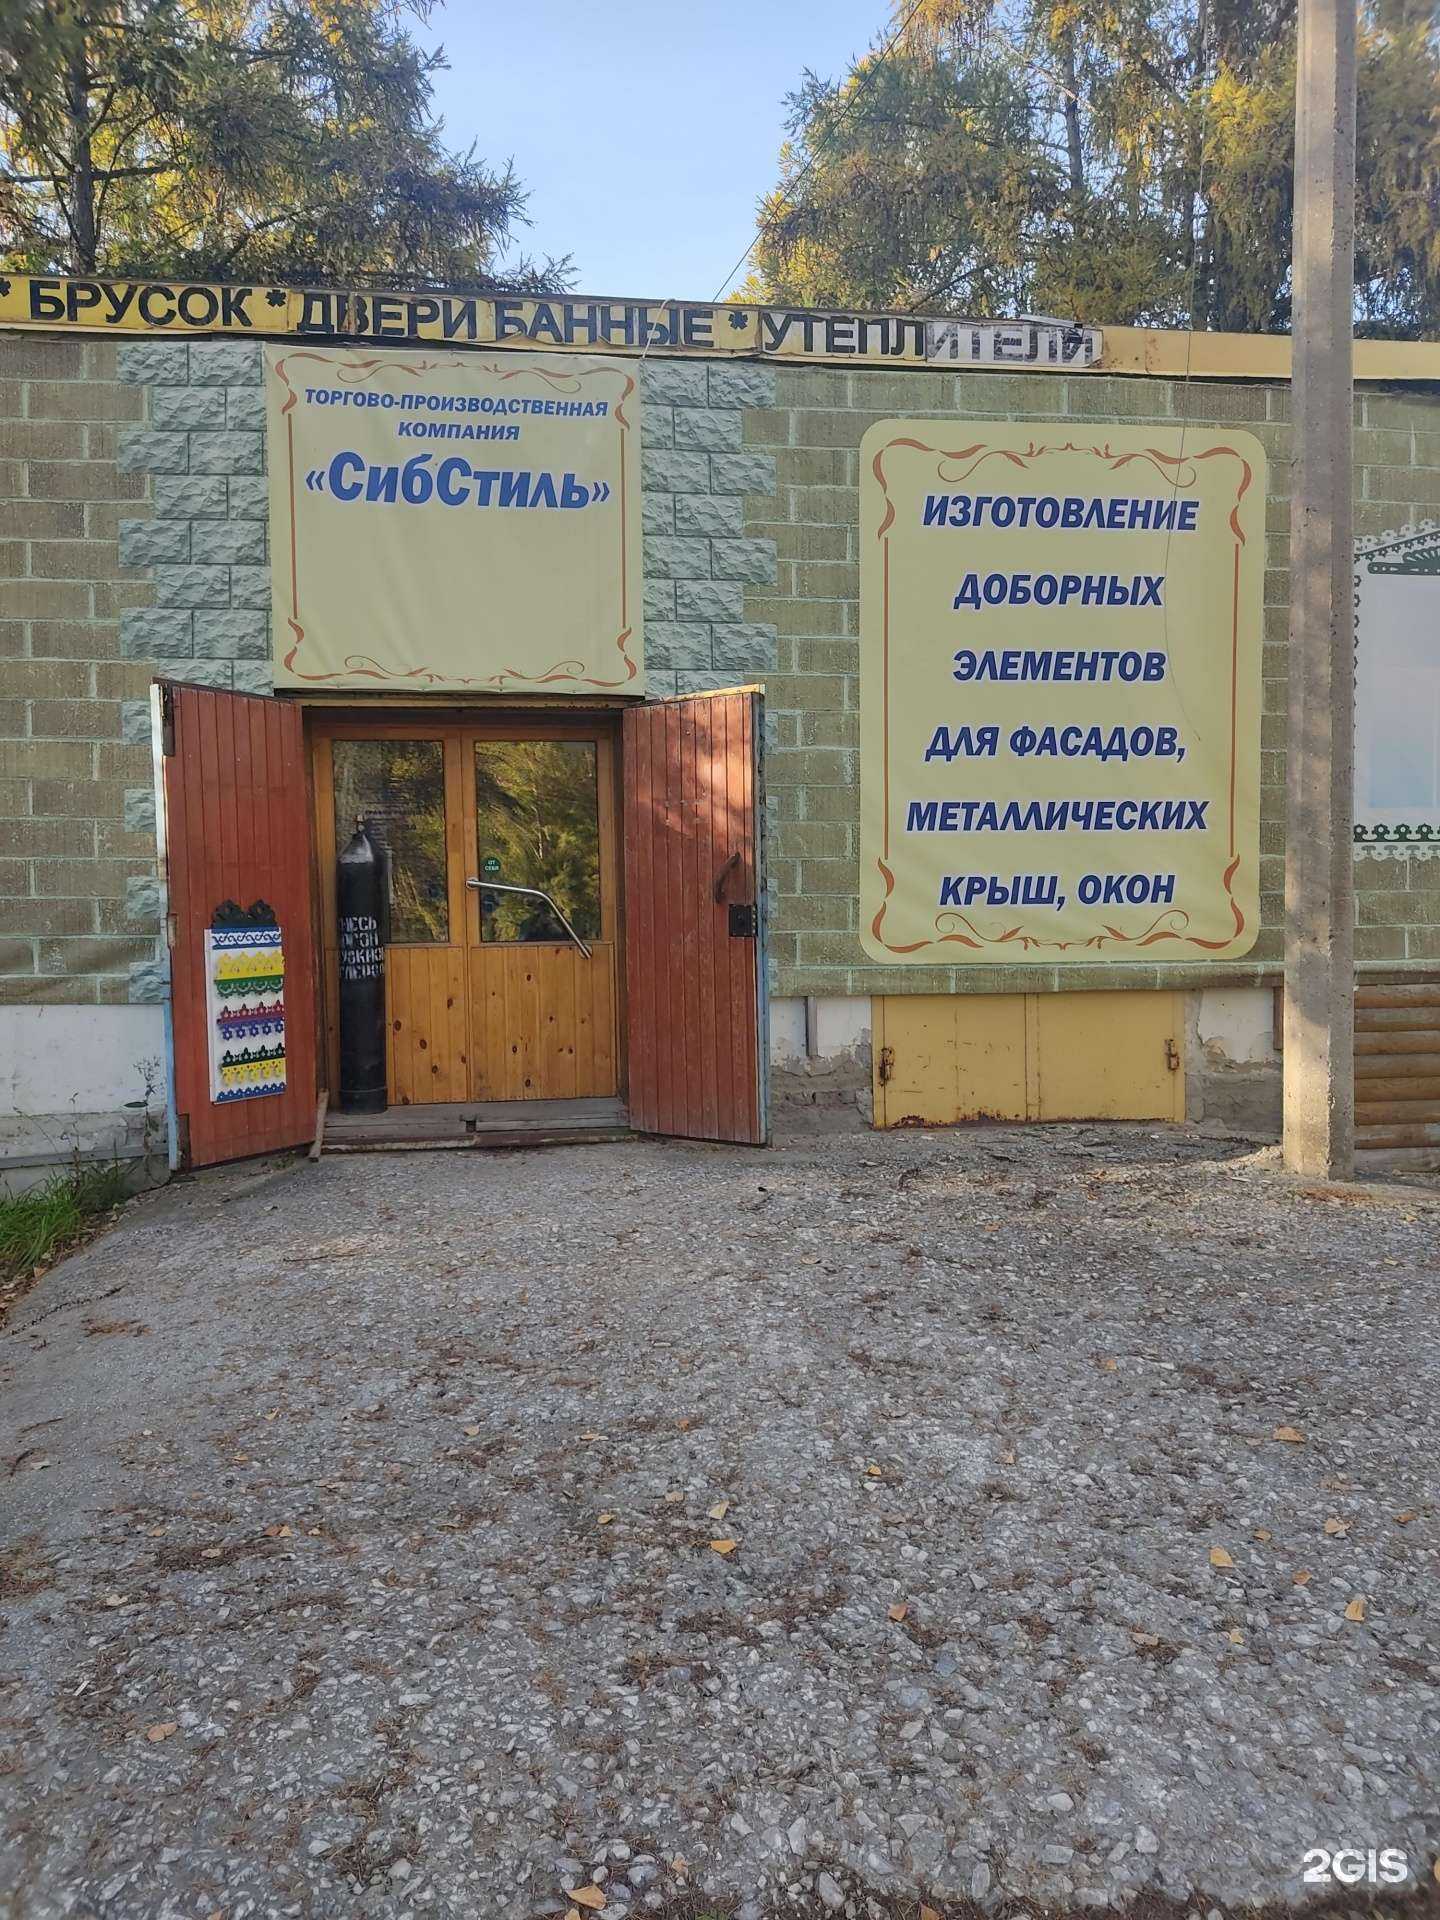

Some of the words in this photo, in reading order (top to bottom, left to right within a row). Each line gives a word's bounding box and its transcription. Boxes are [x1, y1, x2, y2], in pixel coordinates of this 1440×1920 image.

[29, 279, 253, 327] БРУСОК
[296, 294, 478, 340] ДВЕРИ
[496, 301, 715, 348] БАННЫЕ
[761, 313, 1093, 364] УТЕПЛИТЕЛИ
[305, 388, 609, 417] ТОРГОВО-ПРОИЗВОДСТВЕННАЯ
[398, 421, 520, 441] КОМПАНИЯ
[306, 451, 610, 510] «СибСтиль»
[922, 495, 1200, 531] ИЗГОТОВЛЕНИЕ
[953, 573, 1164, 610] ДОБОРНЫХ
[952, 650, 1167, 682] ЭЛЕМЕНТОВ
[925, 726, 1000, 762] ДЛЯ
[1009, 725, 1186, 763] ФАСАДОВ,
[906, 800, 1210, 832] МЕТАЛЛИЧЕСКИХ
[939, 875, 1066, 911] КРЫШ,
[1077, 873, 1176, 905] ОКОН
